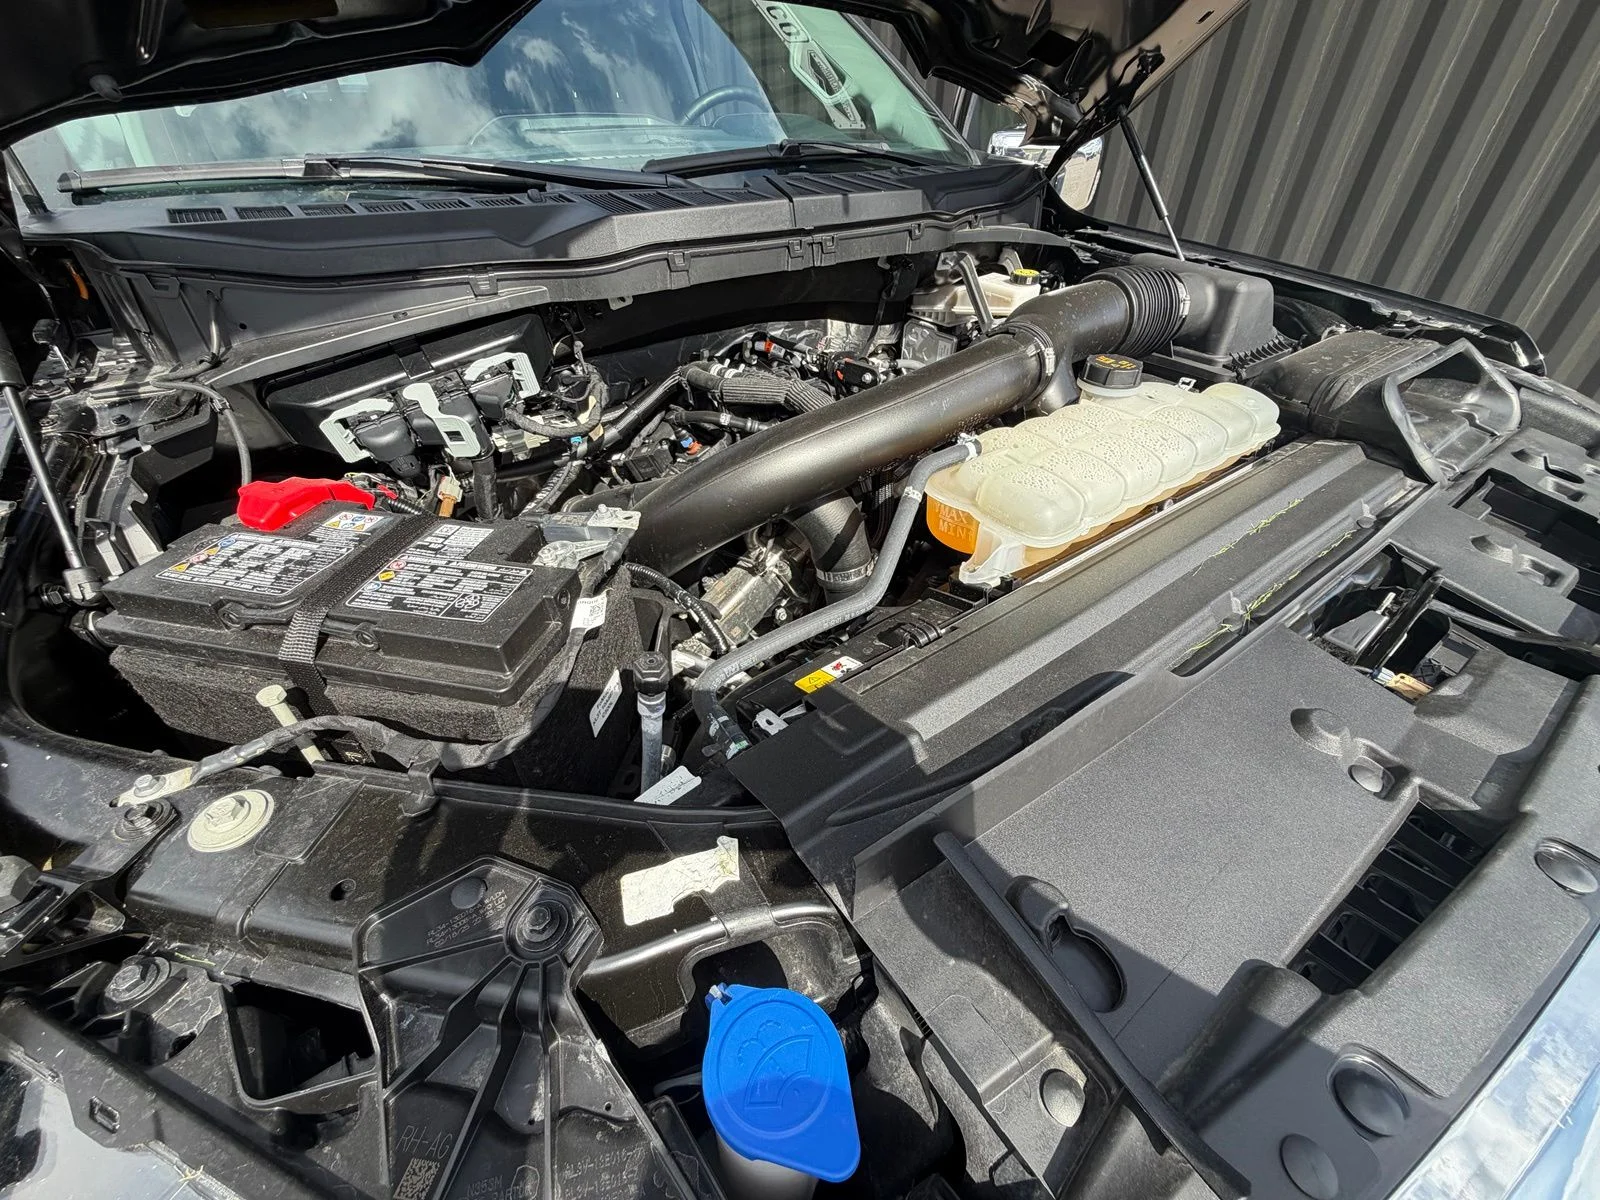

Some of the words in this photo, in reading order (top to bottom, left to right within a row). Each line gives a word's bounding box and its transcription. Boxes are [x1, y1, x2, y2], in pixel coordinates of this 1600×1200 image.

[940, 503, 968, 524] MAX
[939, 519, 966, 540] MIN
[396, 1125, 453, 1159] RH-AG
